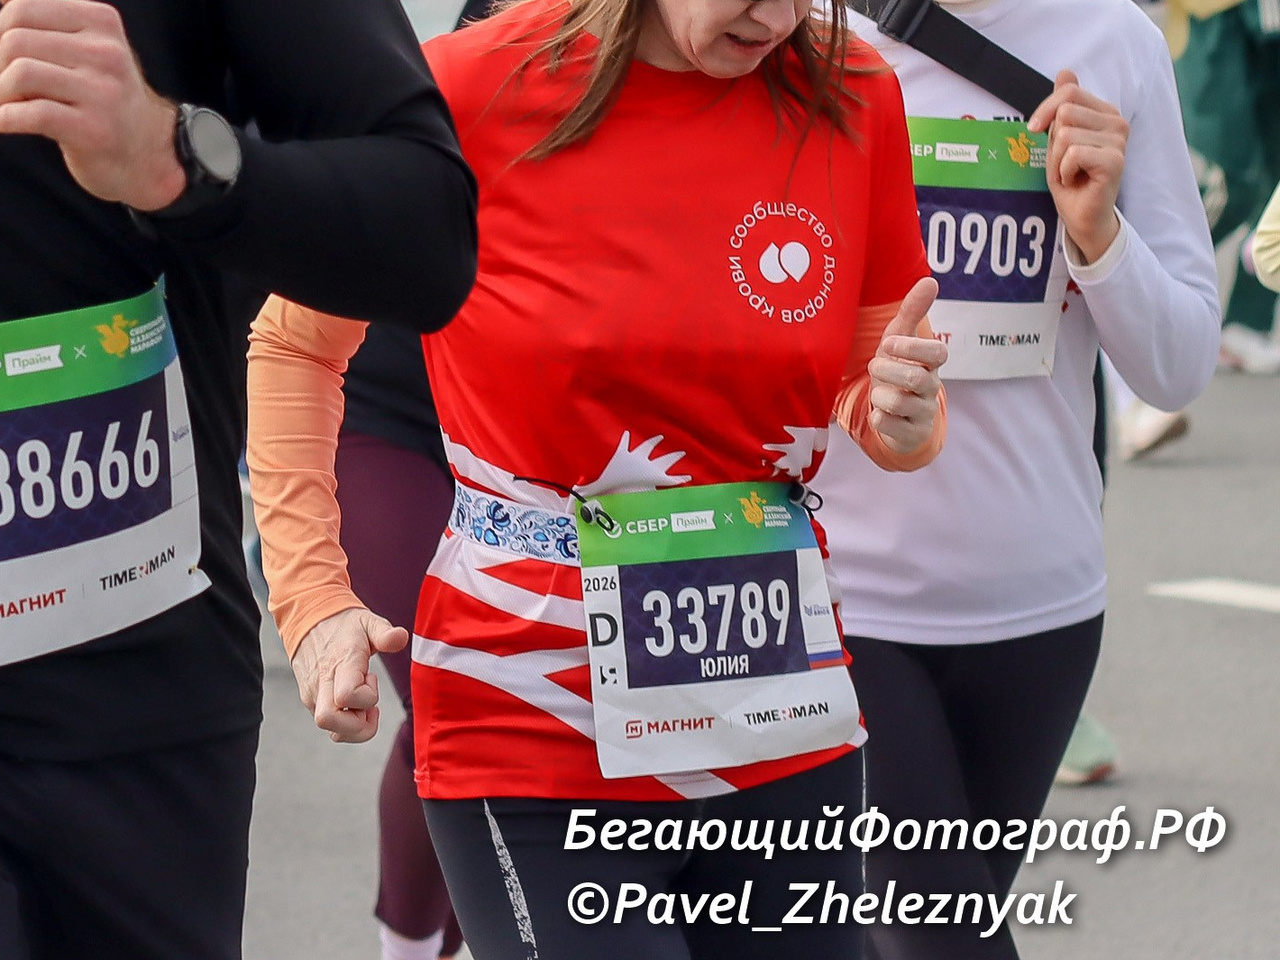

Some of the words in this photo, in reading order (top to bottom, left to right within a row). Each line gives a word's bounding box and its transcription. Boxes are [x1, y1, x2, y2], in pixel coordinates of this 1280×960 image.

[911, 143, 934, 157] ЕР
[730, 200, 833, 249] сообщество
[925, 210, 1046, 278] 0903
[728, 256, 775, 319] крови
[781, 254, 836, 324] доноров
[11, 352, 53, 370] Прайм
[625, 517, 669, 535] СБЕР
[676, 515, 709, 529] Прайм
[583, 575, 617, 593] 2026
[588, 613, 619, 648] D
[641, 578, 791, 658] 33789
[699, 654, 750, 678] ЮЛИЯ
[646, 716, 715, 734] МАГНИТ
